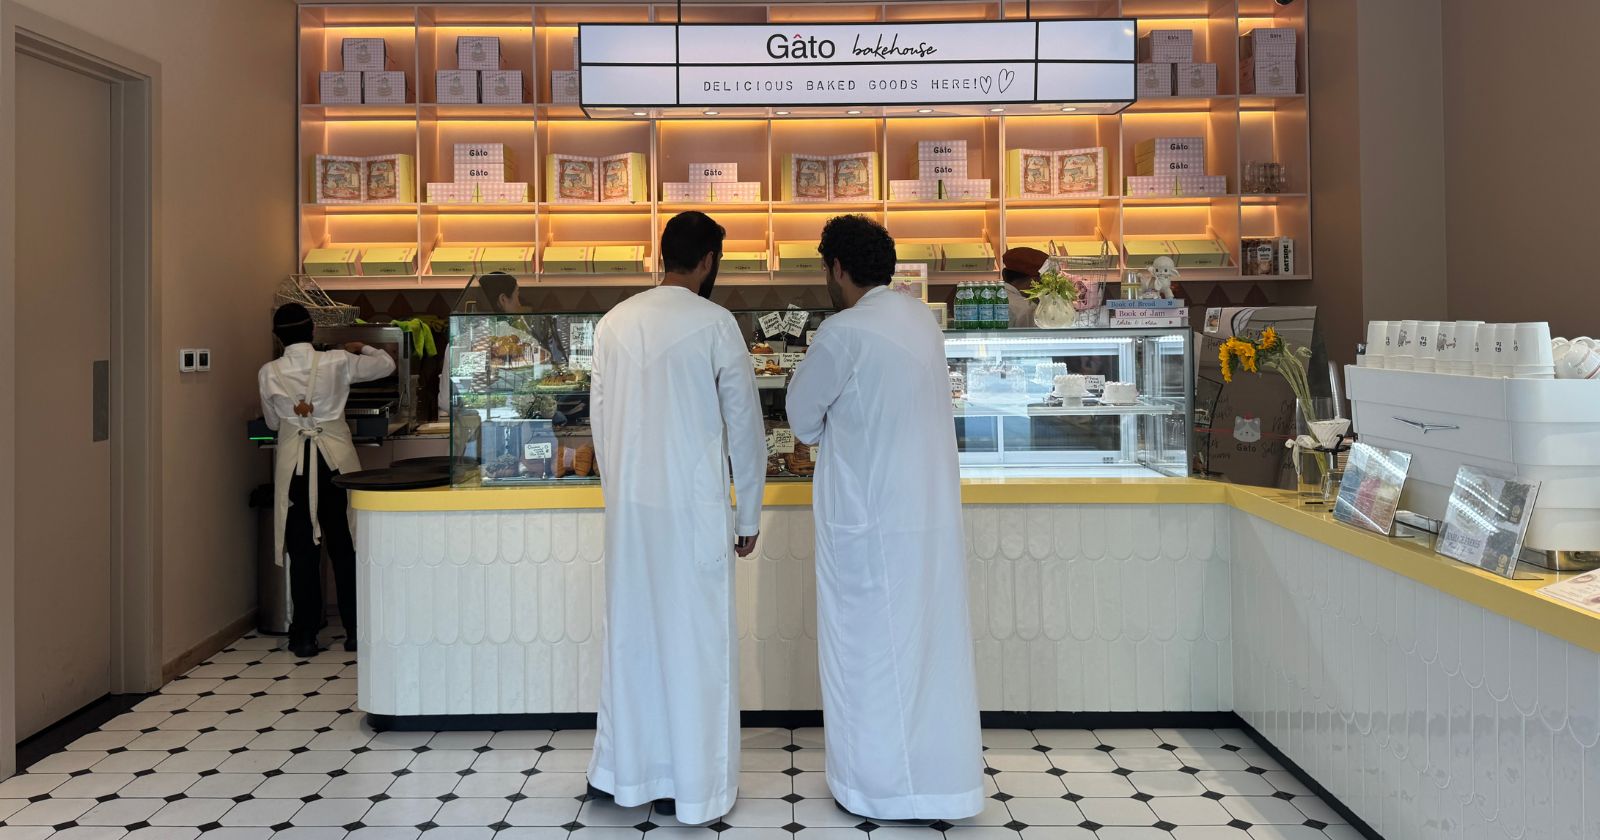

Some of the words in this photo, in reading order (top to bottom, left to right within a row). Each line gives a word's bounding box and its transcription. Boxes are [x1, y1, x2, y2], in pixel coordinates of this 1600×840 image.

[766, 33, 836, 60] Gâto
[852, 32, 938, 60] bakehouse
[703, 80, 793, 92] DELICIOUS
[806, 80, 856, 91] BAKED
[868, 79, 918, 90] GOODS
[931, 77, 977, 90] HERE!
[1140, 309, 1148, 317] of
